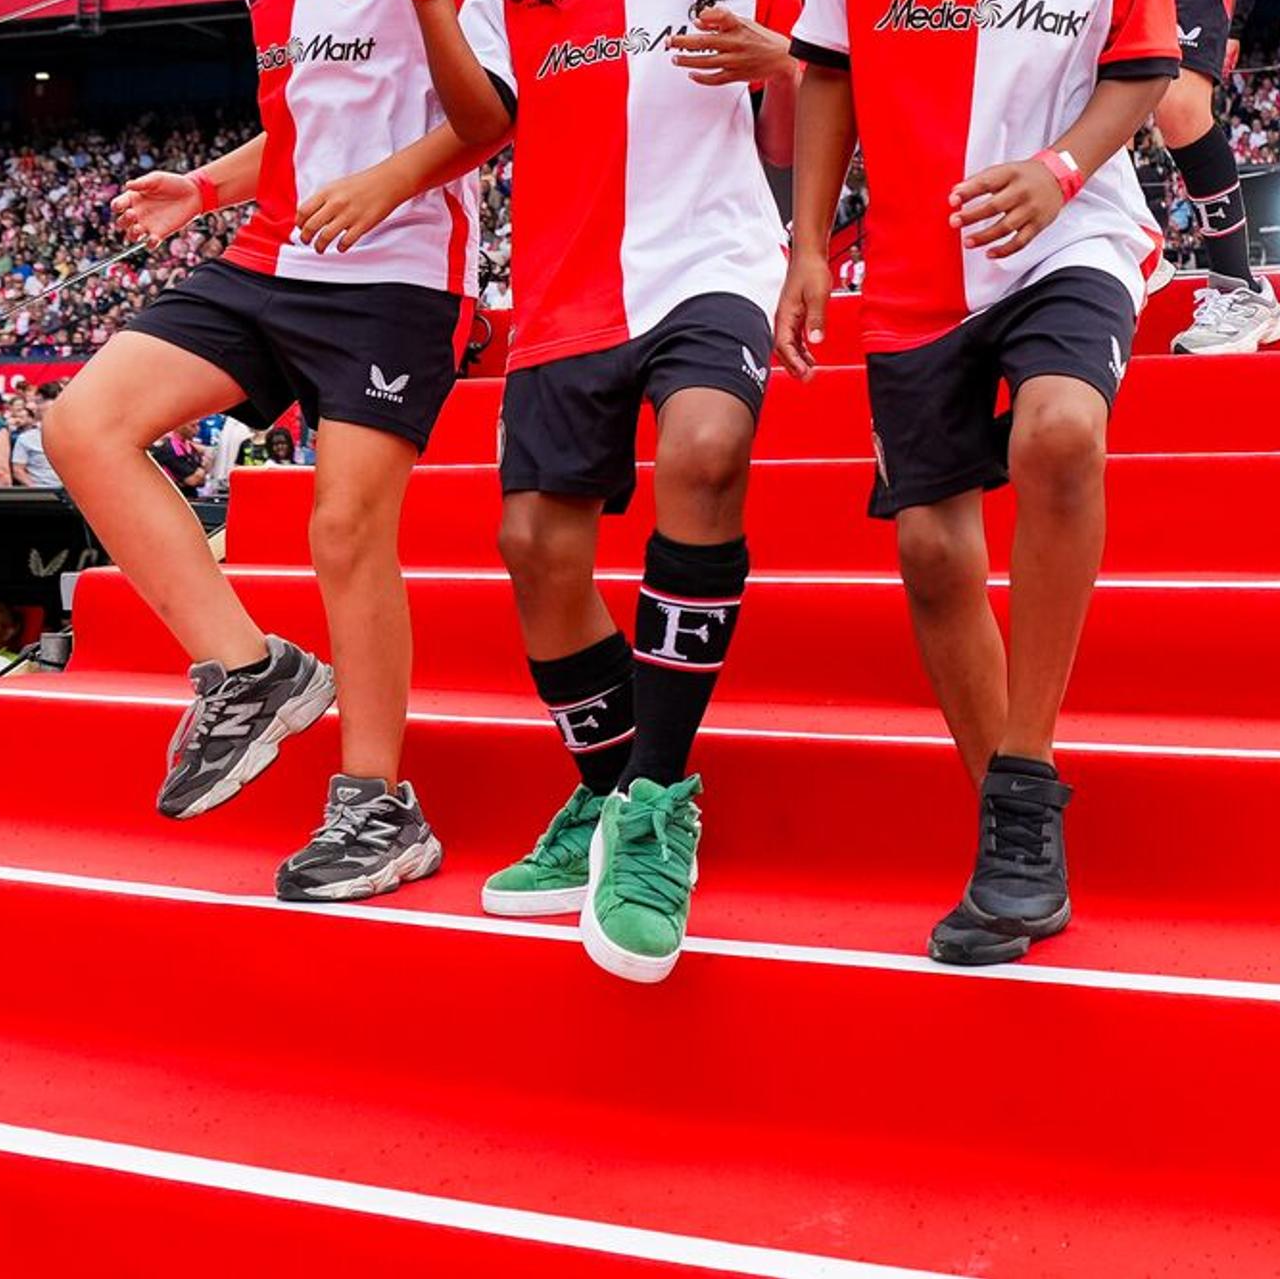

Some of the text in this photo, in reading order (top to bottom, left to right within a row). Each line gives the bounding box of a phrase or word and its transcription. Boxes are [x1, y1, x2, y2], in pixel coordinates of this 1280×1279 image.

[301, 34, 377, 62] Markt
[537, 36, 622, 79] Media
[1193, 195, 1230, 232] F
[651, 602, 728, 660] F
[553, 698, 608, 747] F
